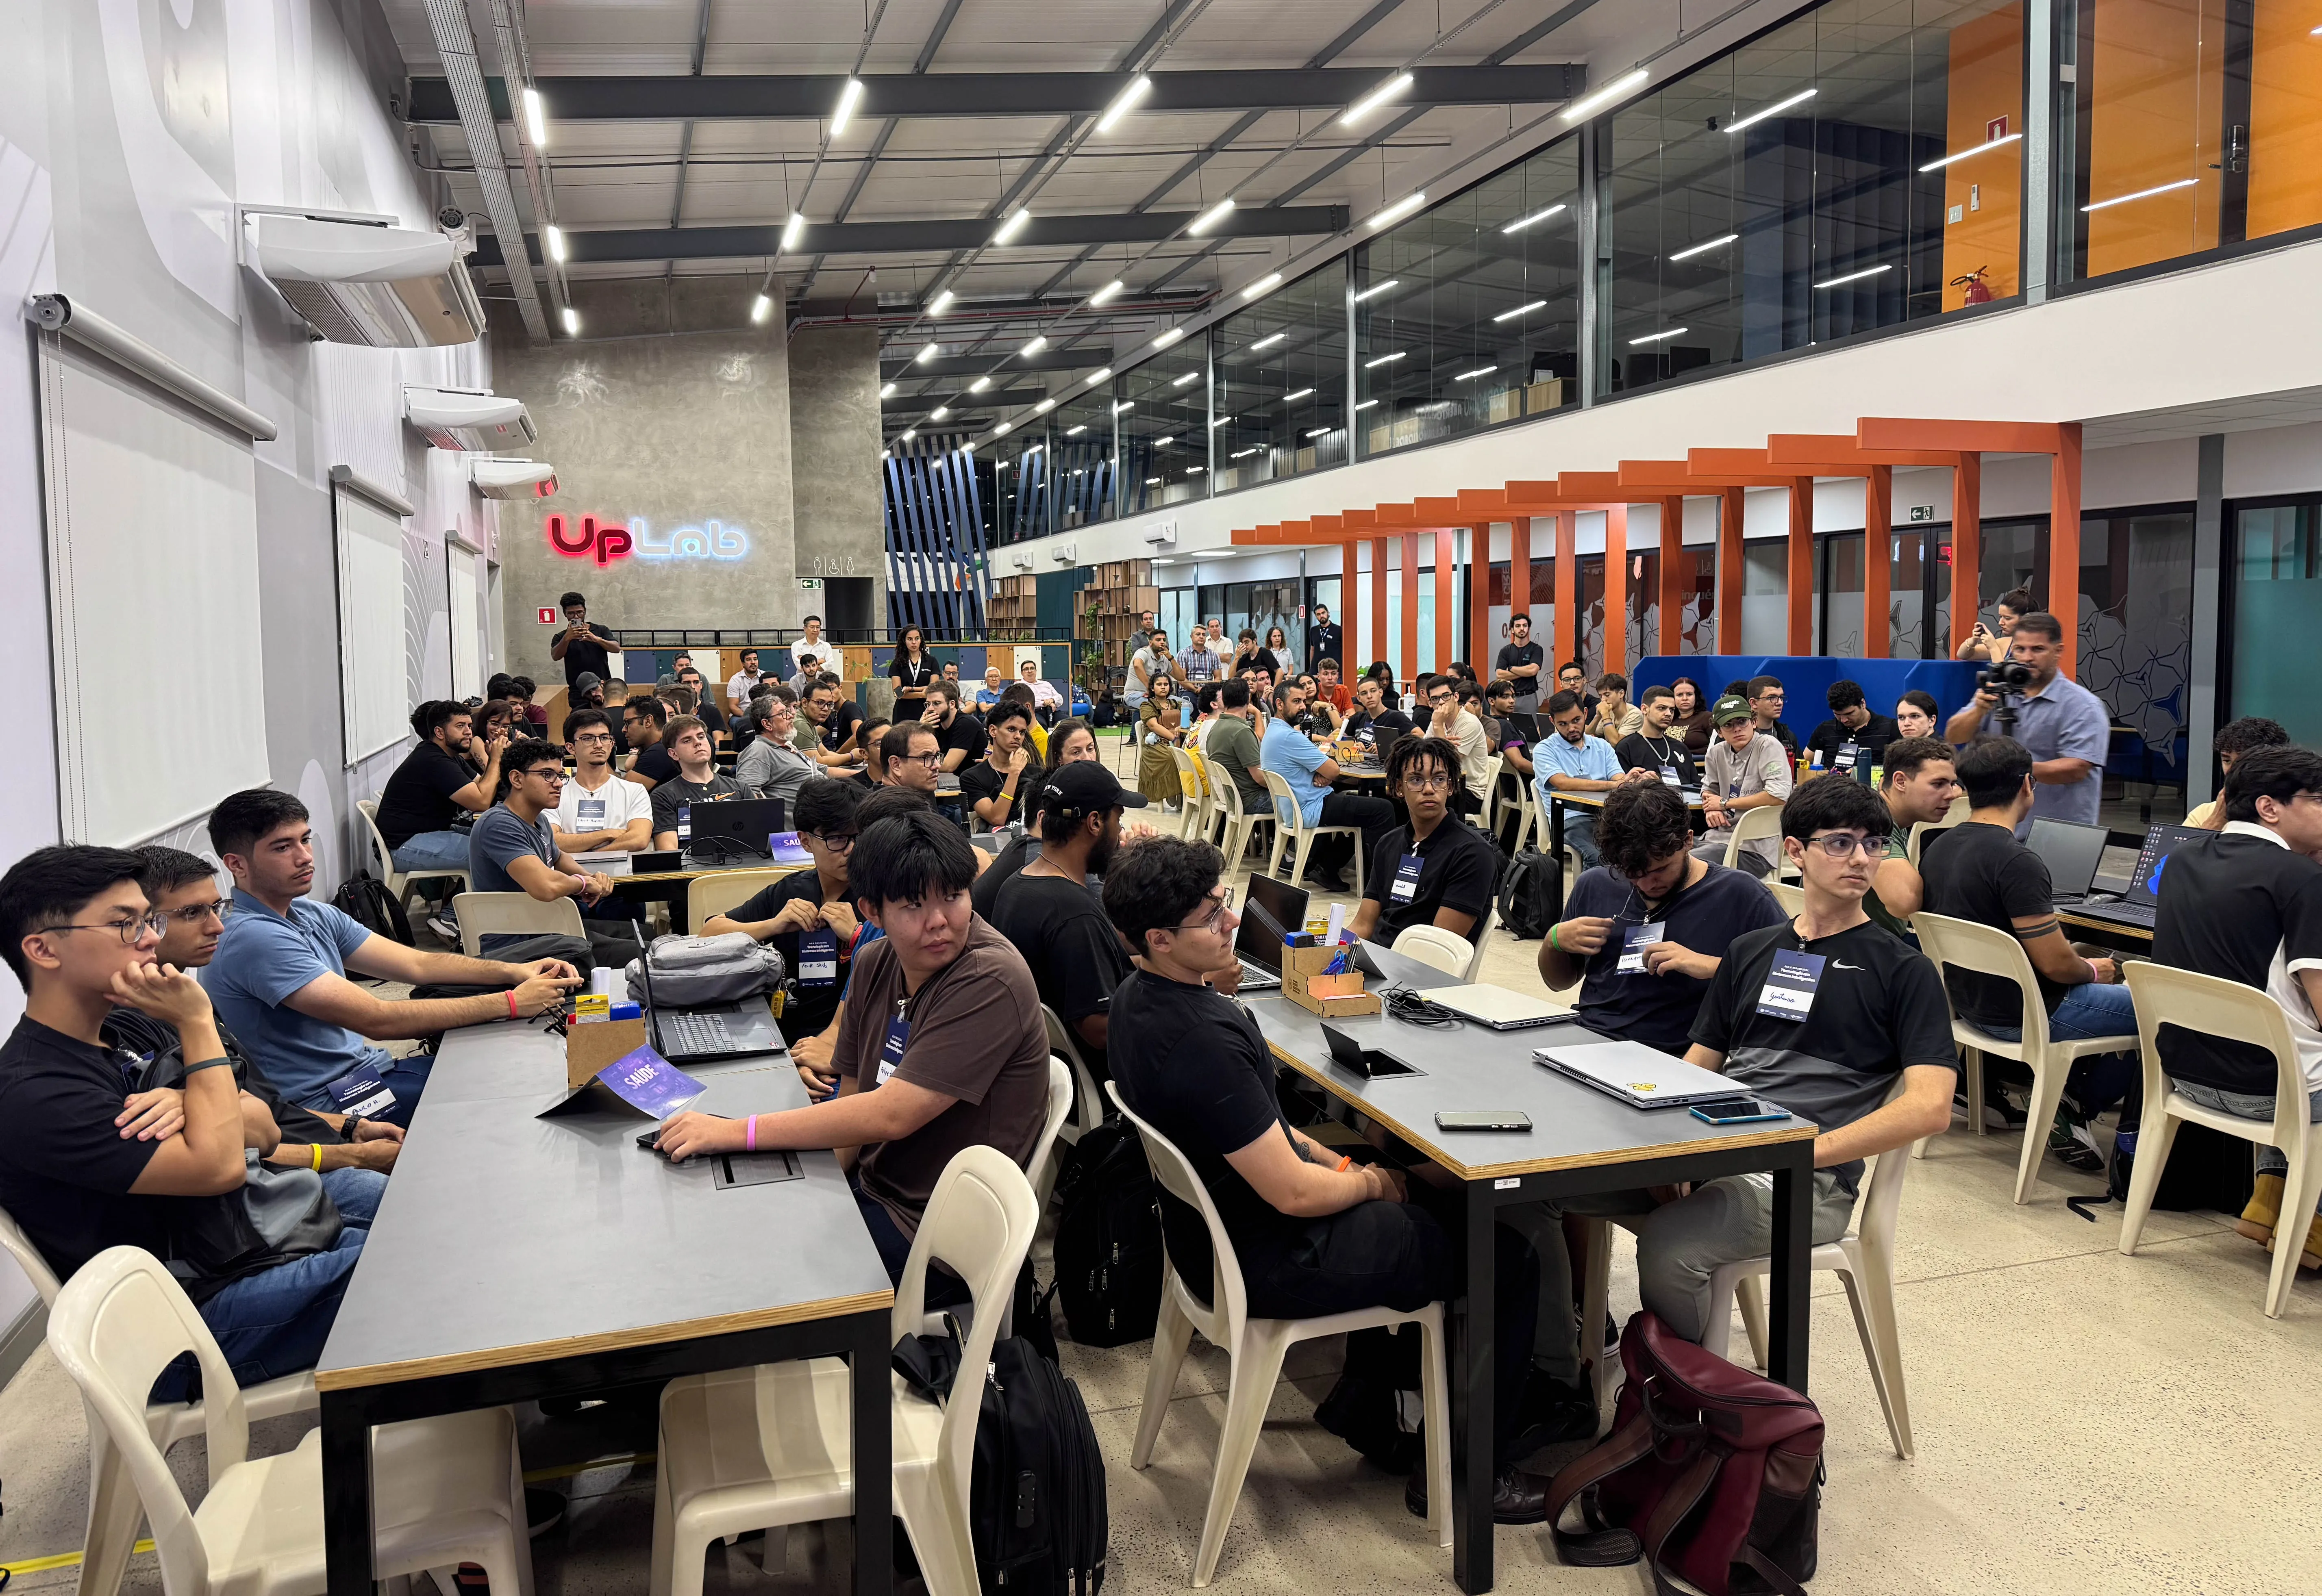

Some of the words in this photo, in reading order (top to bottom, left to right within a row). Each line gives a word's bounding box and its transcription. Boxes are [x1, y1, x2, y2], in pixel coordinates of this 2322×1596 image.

[1051, 785, 1063, 796] YORK
[1769, 992, 1795, 1003] Gustavo
[624, 1064, 660, 1090] SAÚDE
